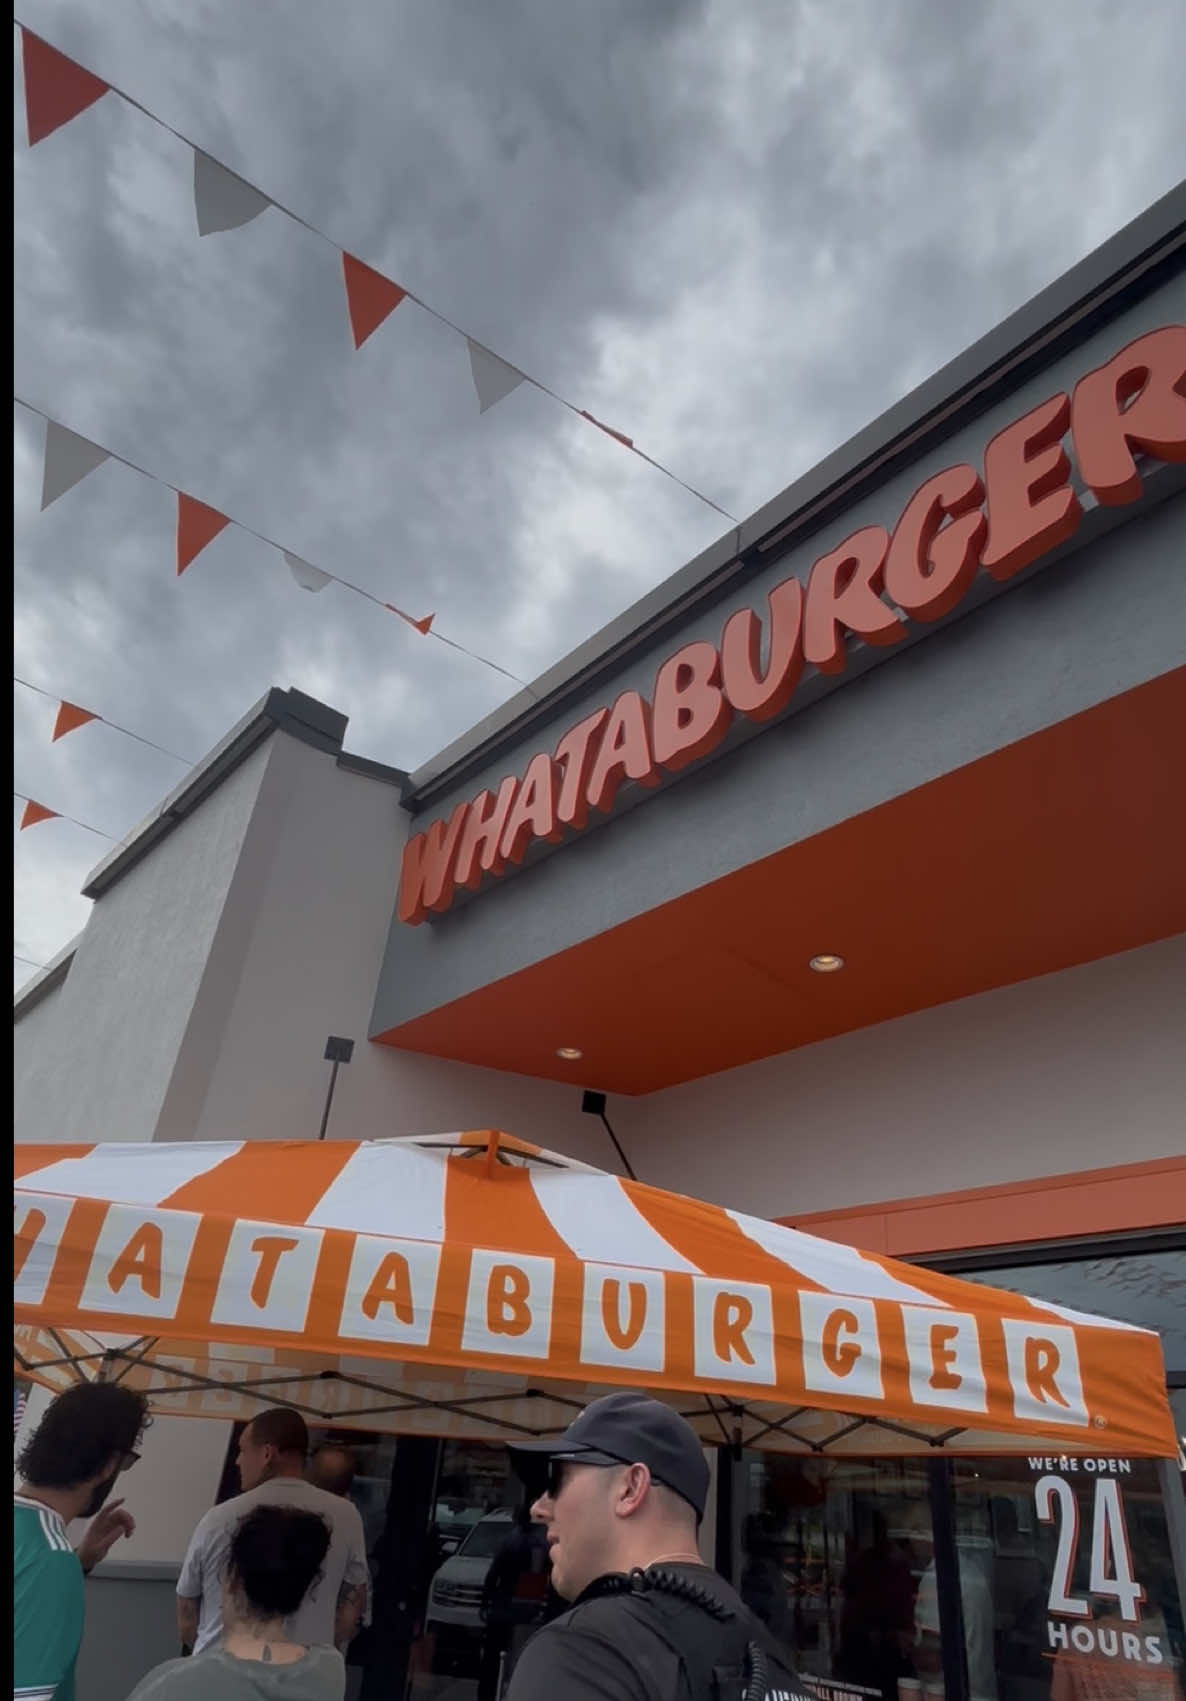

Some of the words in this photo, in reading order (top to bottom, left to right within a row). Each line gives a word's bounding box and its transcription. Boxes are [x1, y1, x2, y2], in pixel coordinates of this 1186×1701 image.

[400, 325, 1186, 925] WHATABURGER
[1028, 1457, 1079, 1470] WE'RE
[1083, 1459, 1131, 1473] OPEN
[1034, 1475, 1146, 1624] 24
[1048, 1620, 1163, 1664] HOURS
